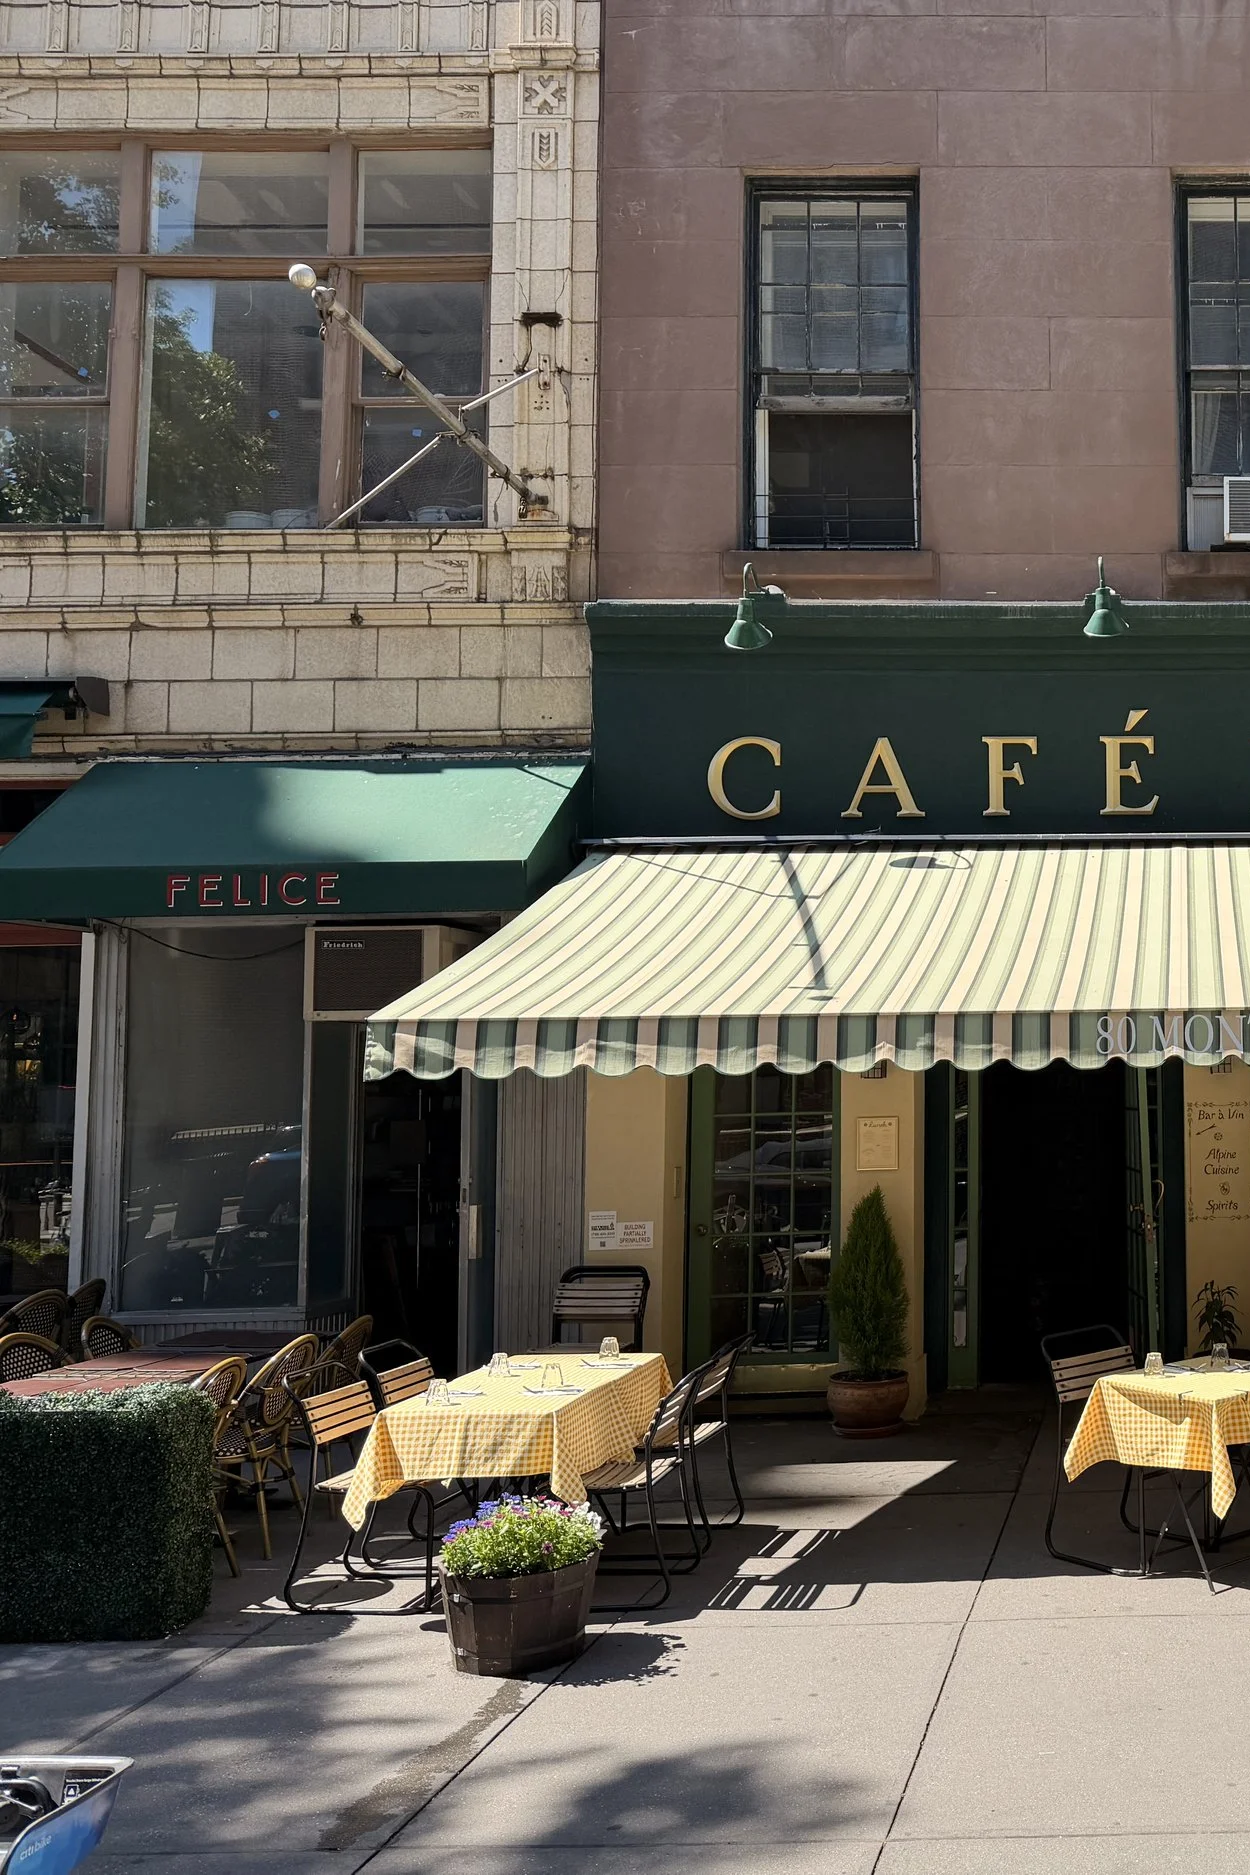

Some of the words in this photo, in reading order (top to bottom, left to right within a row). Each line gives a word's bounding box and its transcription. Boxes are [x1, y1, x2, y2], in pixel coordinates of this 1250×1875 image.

[707, 709, 1160, 820] CAFÉ
[166, 872, 341, 908] FELICE
[323, 941, 363, 949] Friedrich
[1095, 1015, 1137, 1055] 80
[1198, 1109, 1216, 1121] Bar
[1218, 1109, 1224, 1120] à
[1228, 1108, 1244, 1120] Vin
[1204, 1148, 1237, 1163] Alpine
[1203, 1163, 1240, 1176] Cuisine
[1206, 1199, 1239, 1214] Spirits
[624, 1223, 646, 1231] BUILDING
[619, 1236, 651, 1244] SPRINKLERED
